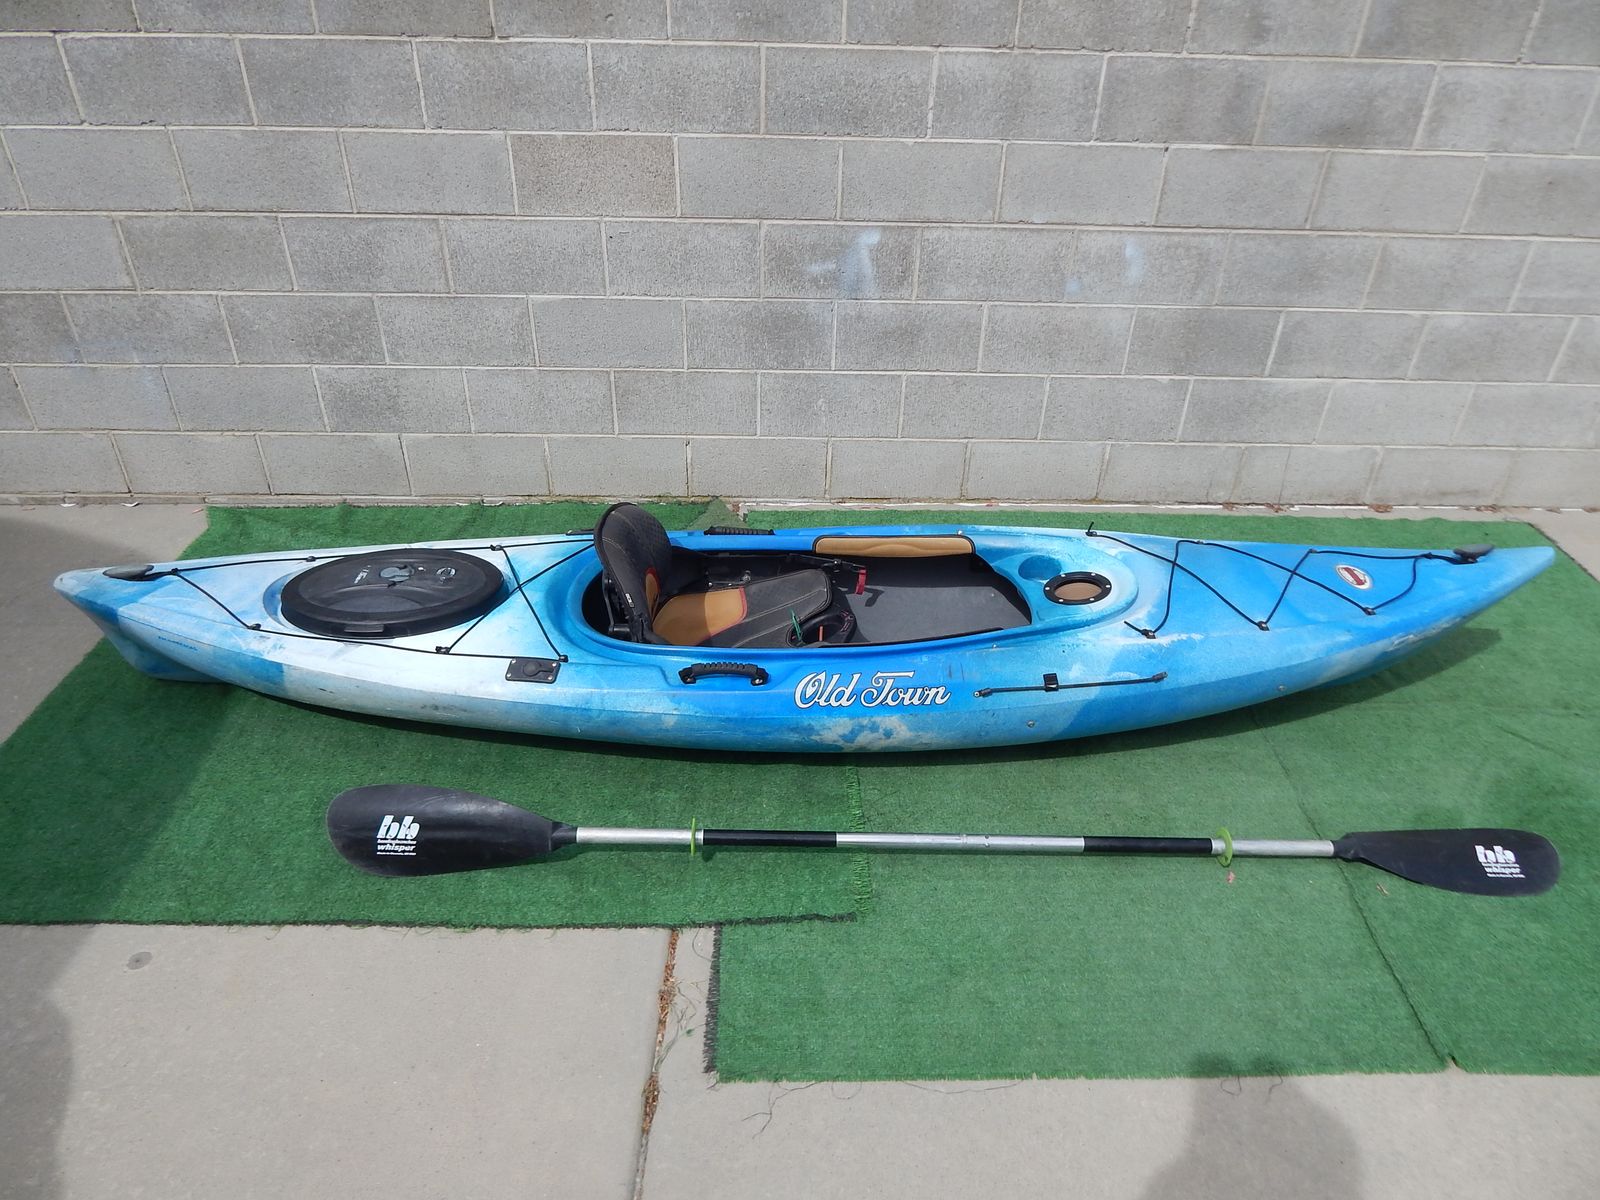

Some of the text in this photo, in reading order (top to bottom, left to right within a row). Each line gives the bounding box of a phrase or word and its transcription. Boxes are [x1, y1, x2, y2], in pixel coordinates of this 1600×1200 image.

[794, 670, 952, 709] Old Town
[377, 844, 416, 852] whisper
